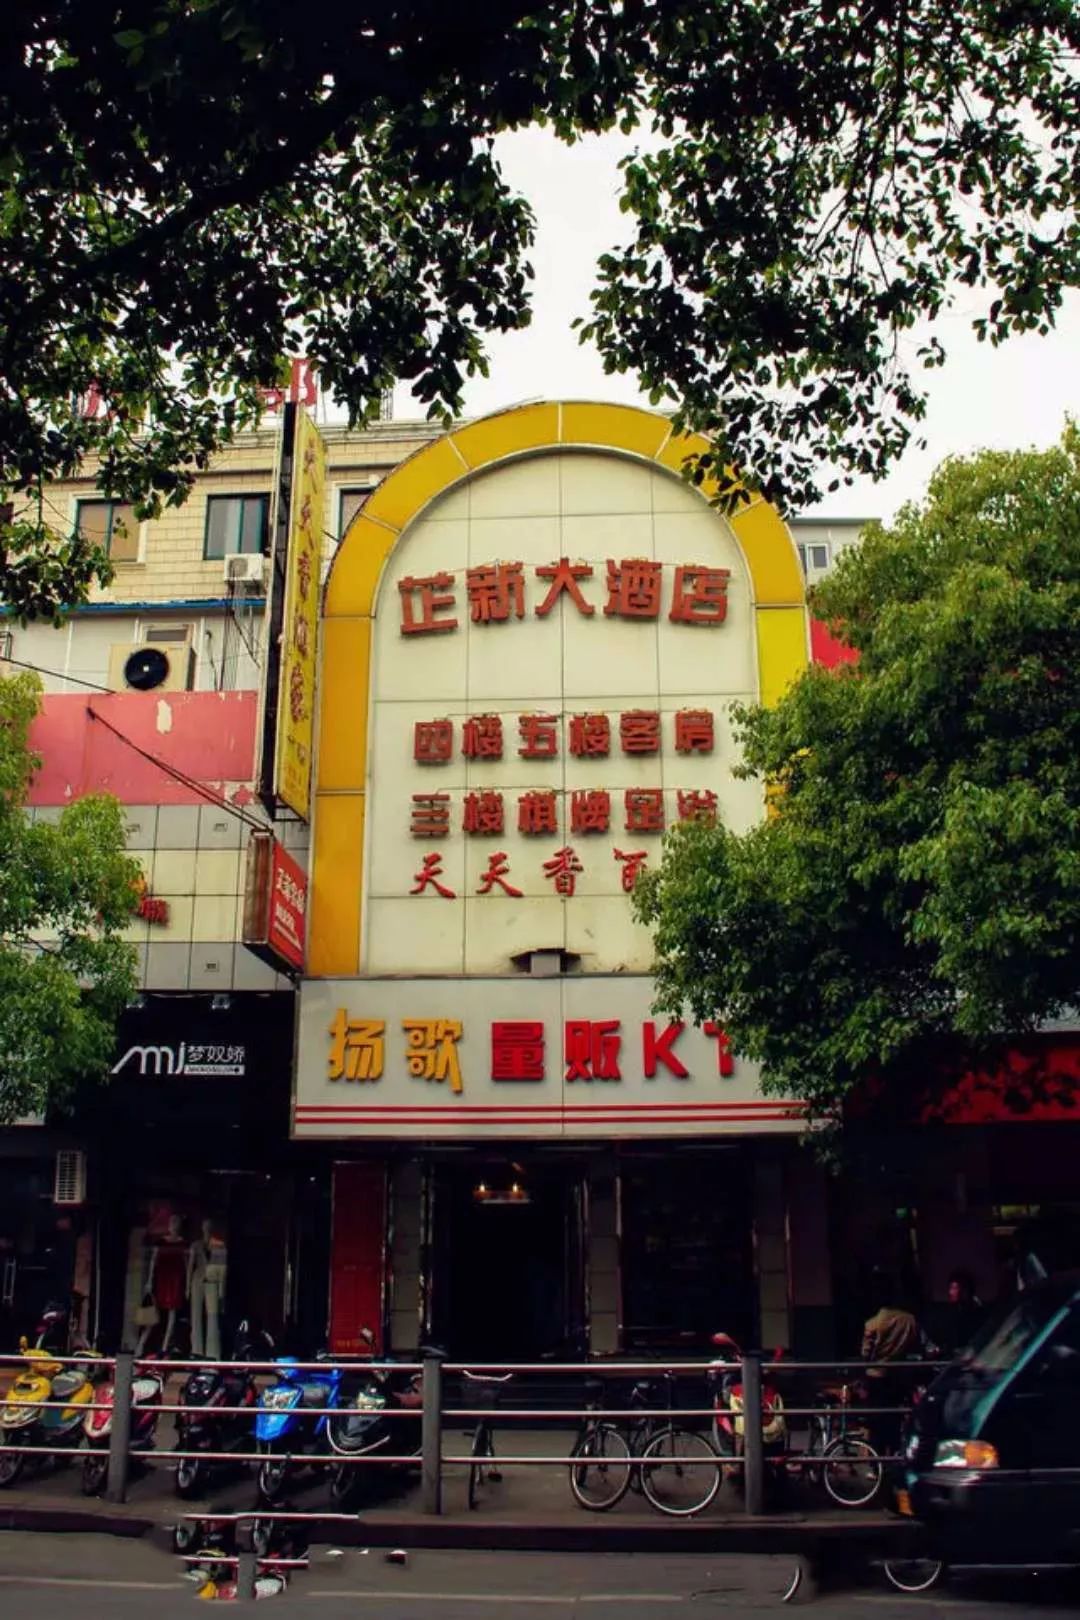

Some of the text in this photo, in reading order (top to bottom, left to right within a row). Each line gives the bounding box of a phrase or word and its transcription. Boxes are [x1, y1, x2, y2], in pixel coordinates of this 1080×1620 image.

[413, 710, 715, 764] 四楼五楼客房
